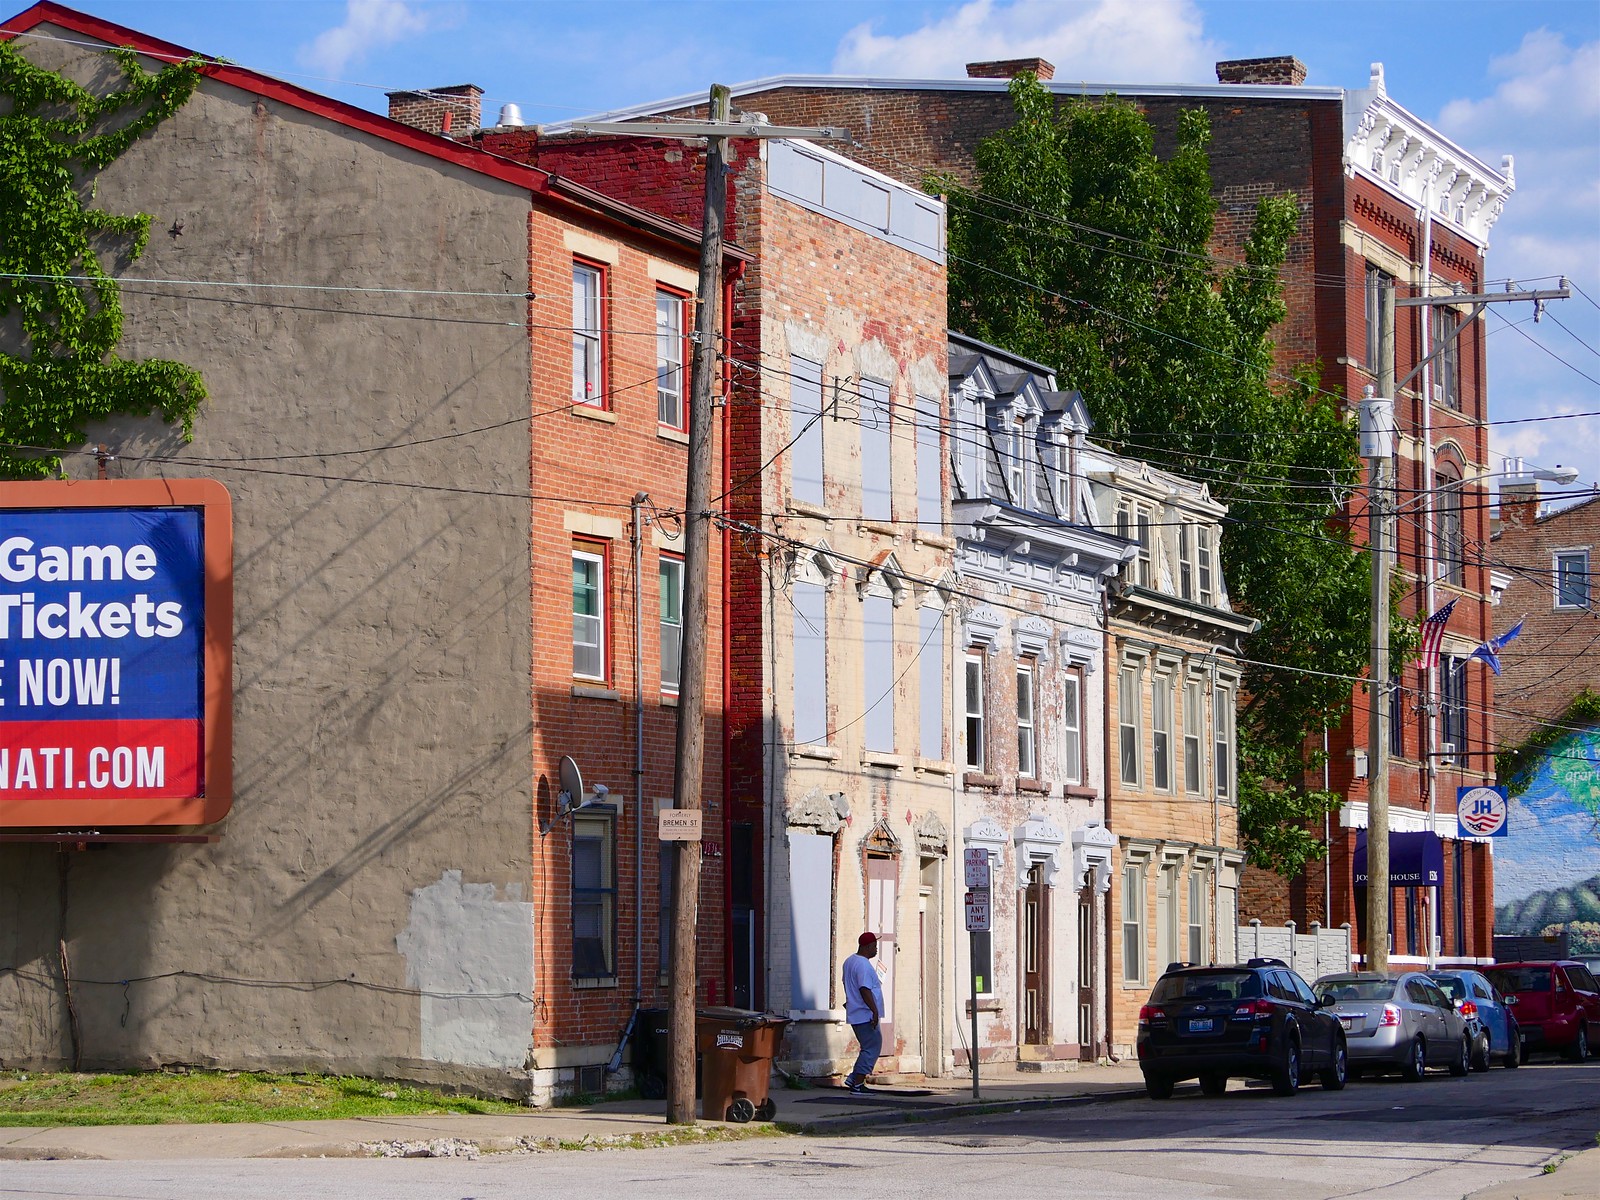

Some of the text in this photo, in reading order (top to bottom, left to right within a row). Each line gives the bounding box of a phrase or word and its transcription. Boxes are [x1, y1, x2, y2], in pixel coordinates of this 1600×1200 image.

[0, 536, 157, 583] Game
[0, 591, 183, 639] Tickets
[19, 657, 120, 707] NOW!
[0, 746, 165, 791] ATI.COM
[1461, 790, 1482, 806] JOSEPH
[1472, 799, 1492, 815] JH
[965, 859, 987, 867] PARKING
[1390, 873, 1420, 881] HOUSE
[965, 894, 973, 903] NO
[970, 906, 984, 914] ANY
[970, 915, 985, 923] TIME
